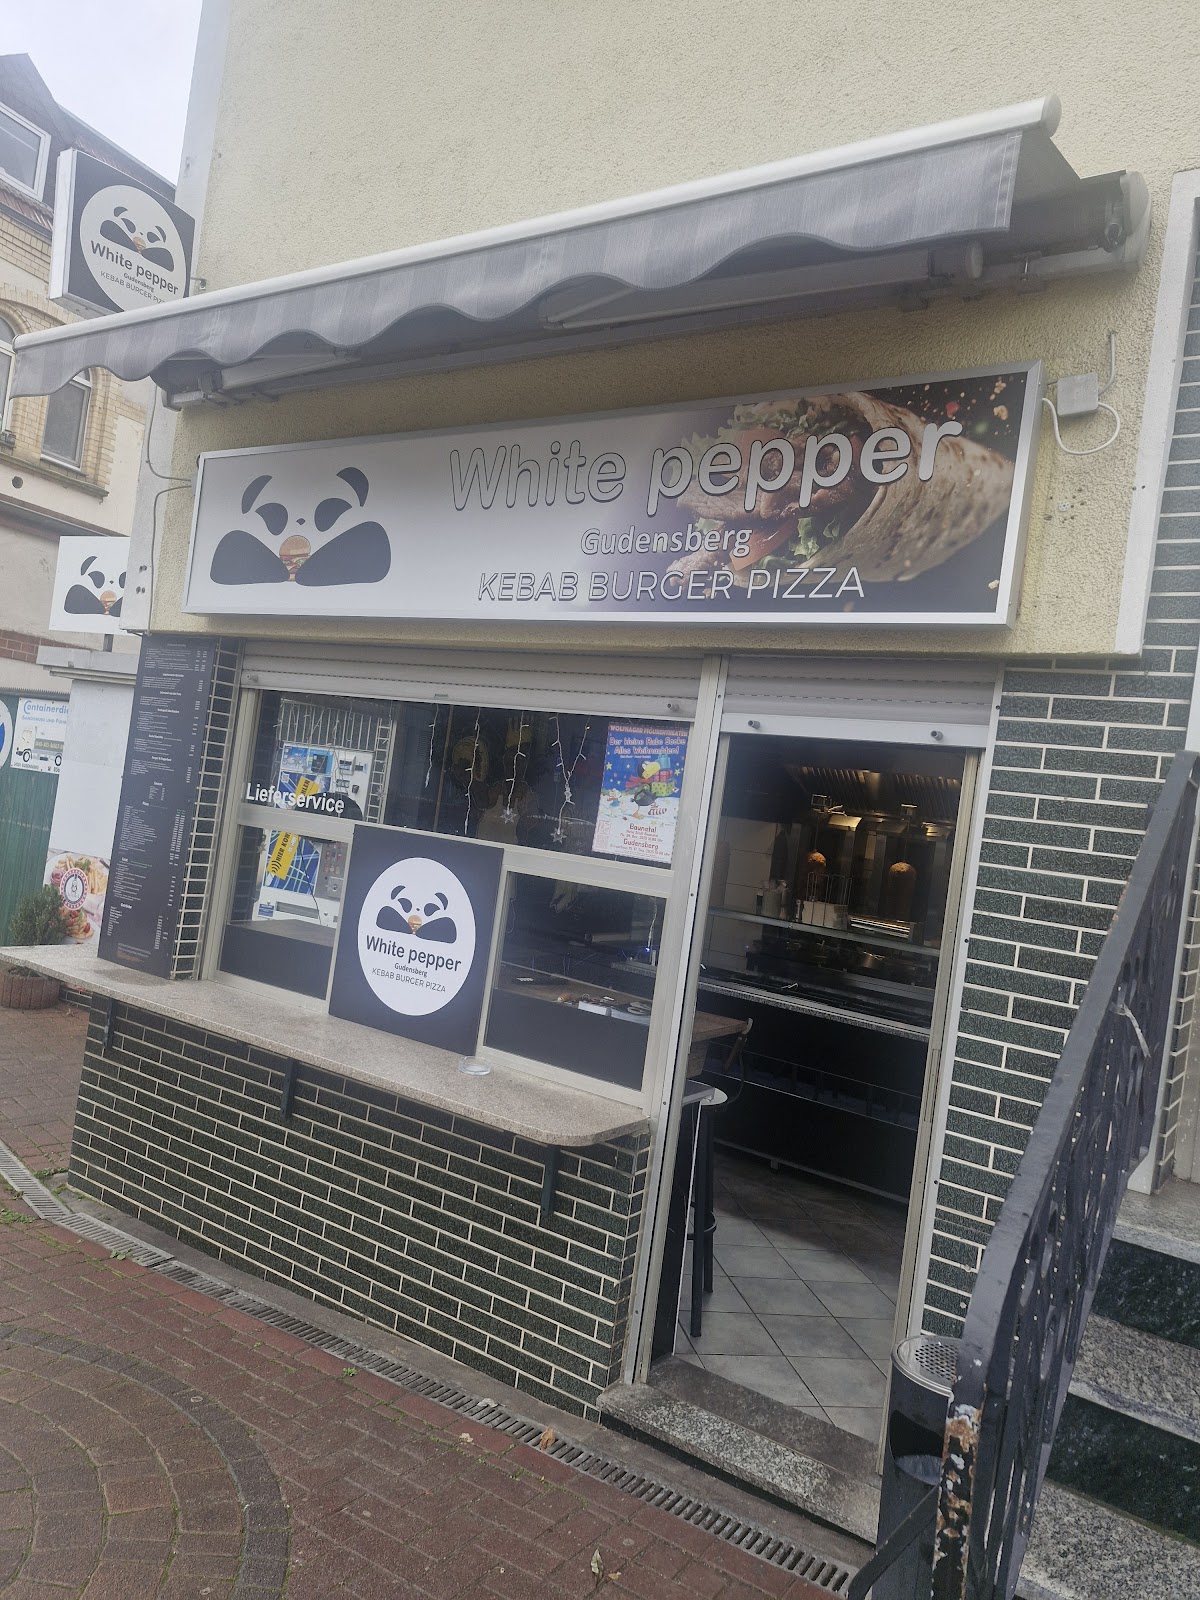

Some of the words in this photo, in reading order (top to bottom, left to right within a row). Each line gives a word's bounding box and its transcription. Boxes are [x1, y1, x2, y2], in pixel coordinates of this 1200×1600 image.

[90, 239, 133, 270] White
[136, 264, 179, 295] pepper
[123, 272, 155, 293] Gudensberg
[100, 270, 125, 286] KEBAB
[125, 282, 152, 300] BURGER
[449, 439, 627, 512] White
[646, 419, 963, 518] pepper
[580, 525, 754, 558] Gudensberg
[477, 571, 579, 602] KEBAB
[588, 569, 735, 602] BURGER
[746, 566, 866, 600] PIZZA
[245, 782, 345, 814] Lieferservice
[629, 822, 657, 833] Baunatal
[623, 838, 659, 850] Gudensberg
[366, 934, 405, 958] White
[407, 947, 462, 972] pepper
[371, 967, 395, 980] KEBAB
[395, 973, 425, 988] BURGER
[425, 980, 447, 993] PIZZA
[394, 962, 428, 978] Gudensberg
